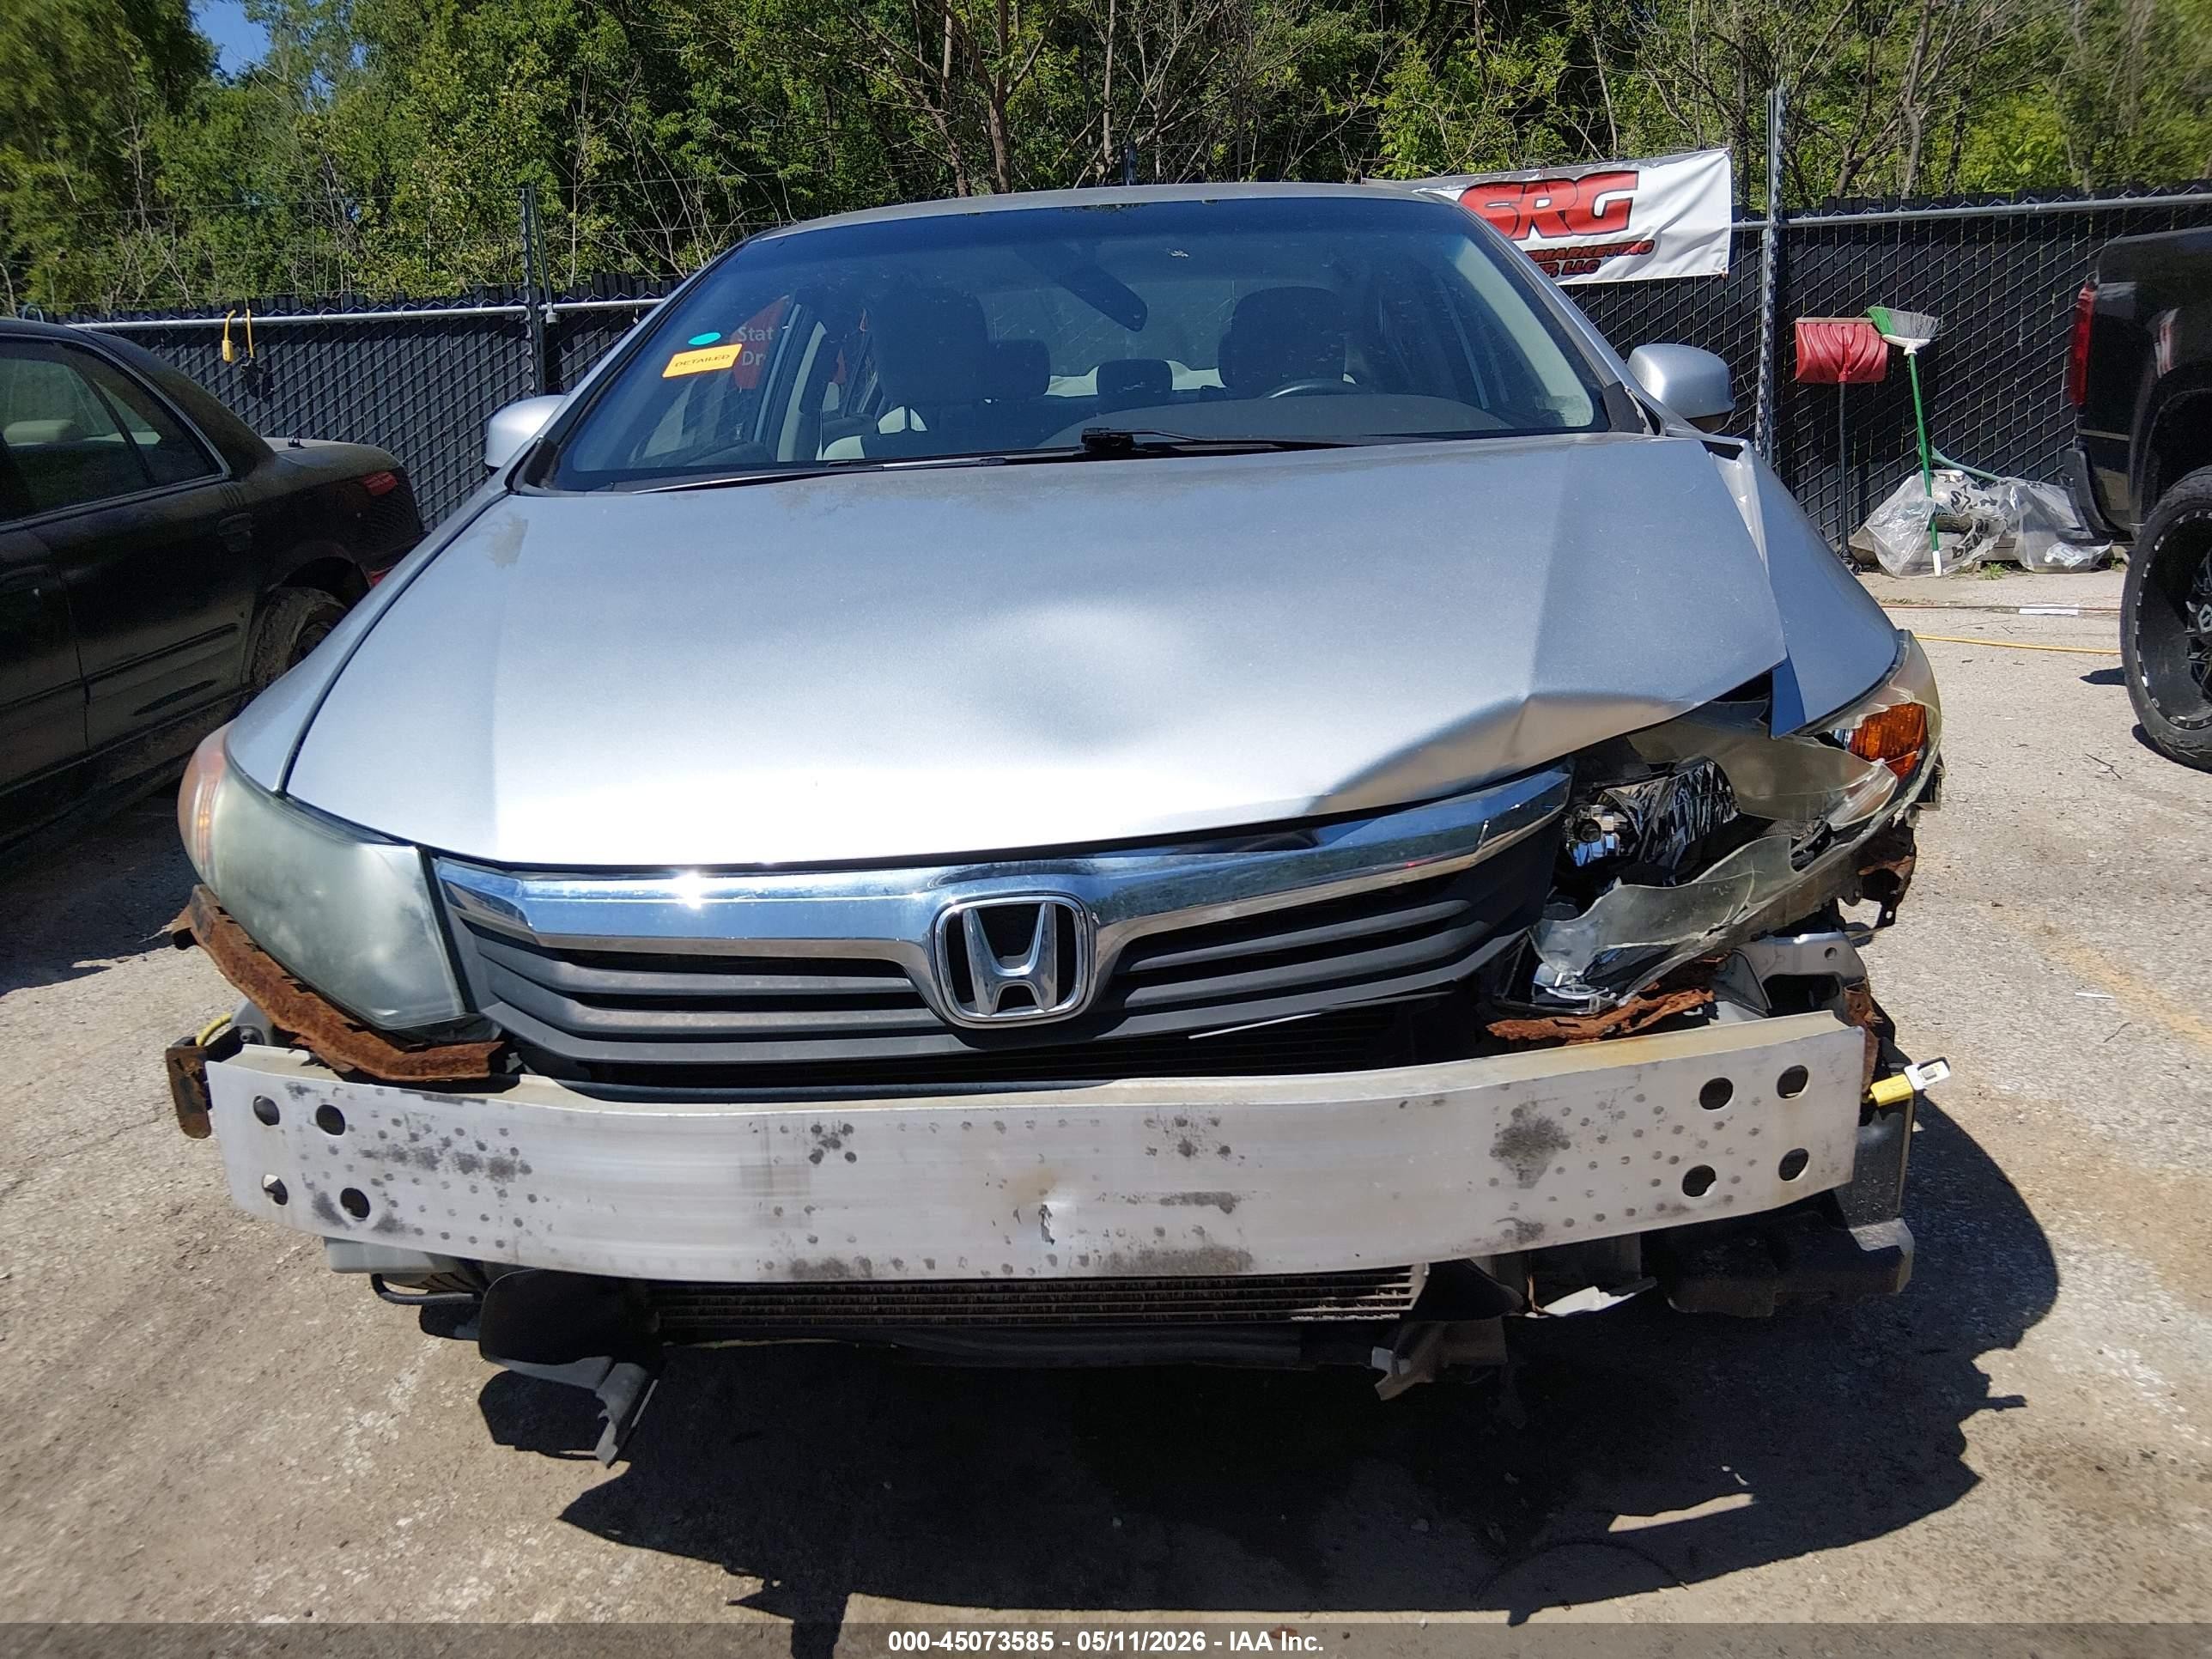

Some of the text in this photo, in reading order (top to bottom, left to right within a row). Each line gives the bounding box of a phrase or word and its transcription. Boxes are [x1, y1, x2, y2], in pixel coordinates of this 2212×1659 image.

[1458, 170, 1639, 240] SRG
[1561, 259, 1601, 276] LLC
[674, 354, 731, 368] DETAILED
